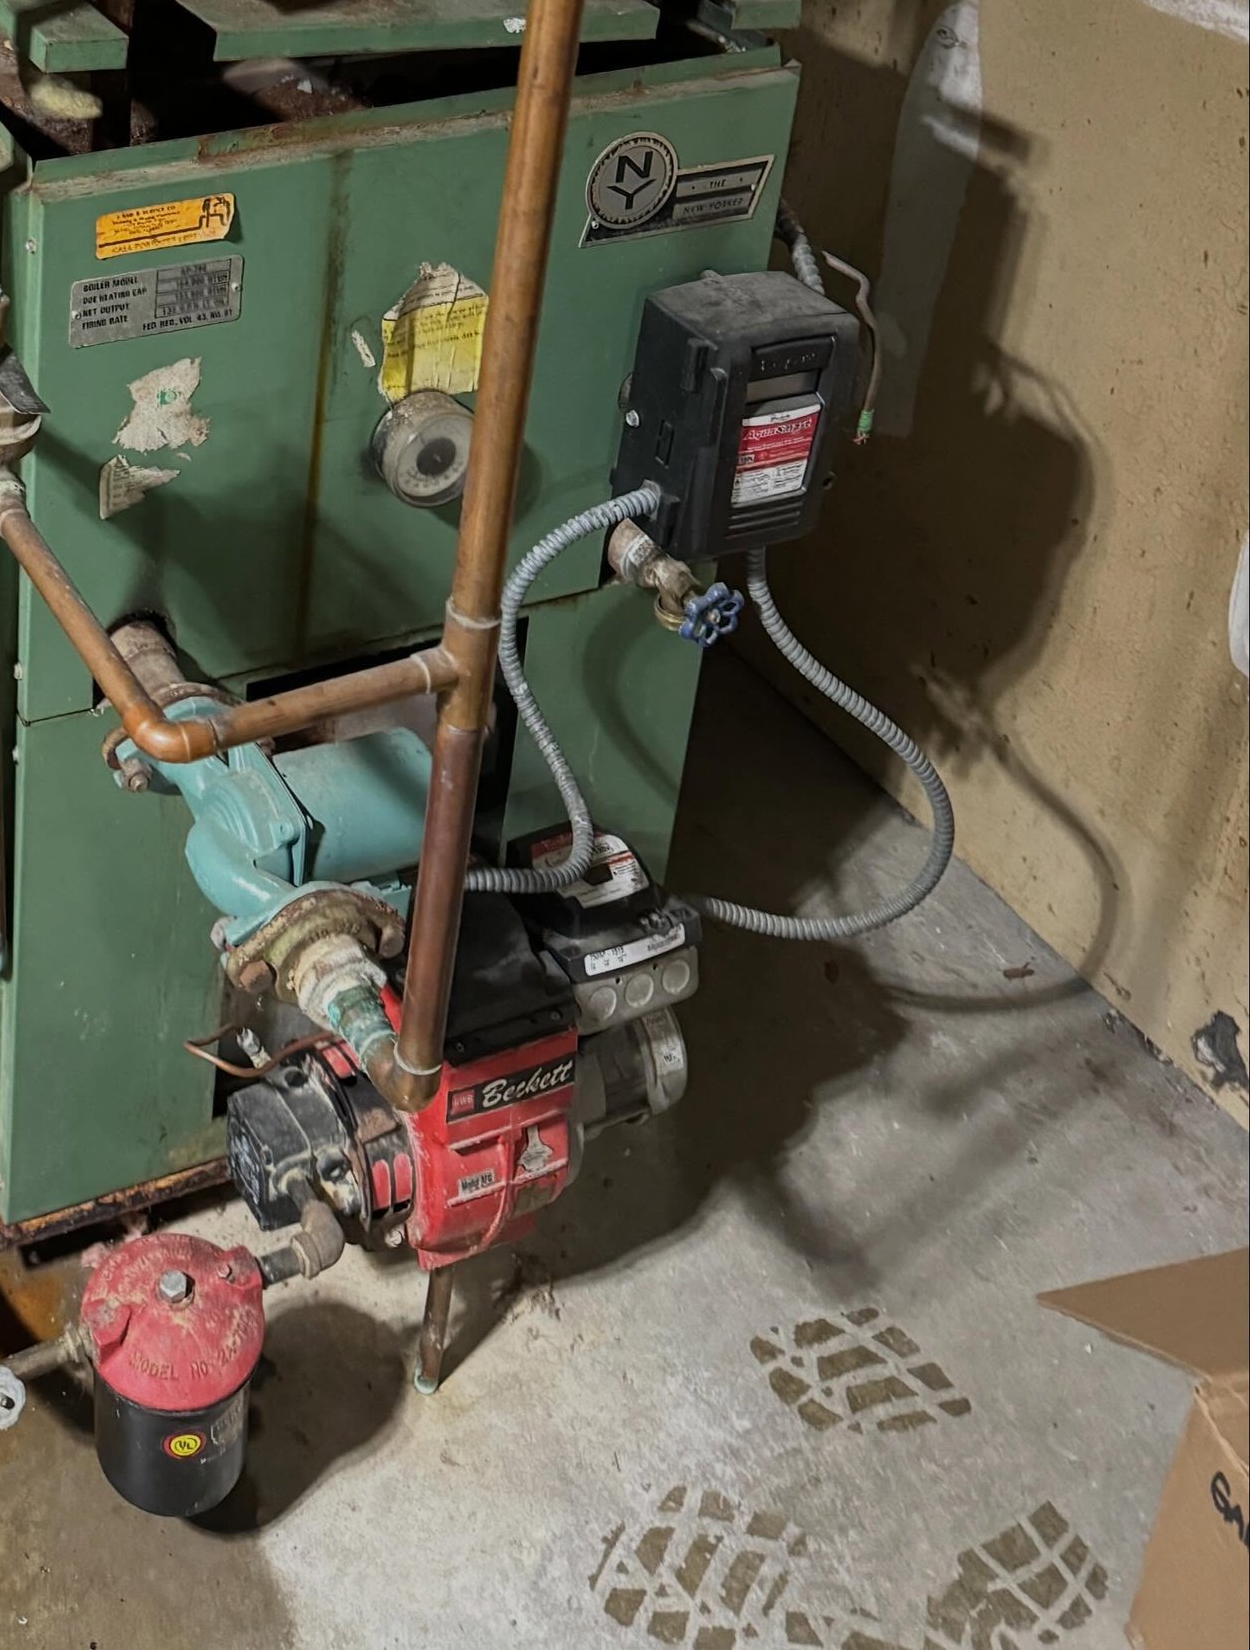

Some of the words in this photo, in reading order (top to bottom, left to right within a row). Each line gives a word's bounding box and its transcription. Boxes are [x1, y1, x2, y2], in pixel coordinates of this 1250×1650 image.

[709, 179, 727, 189] THE
[83, 279, 111, 292] BOILER
[112, 276, 138, 288] MODEL
[99, 292, 131, 303] HEATING
[83, 307, 98, 318] NET
[100, 303, 130, 315] OUTPUT
[482, 1059, 574, 1109] Beckett
